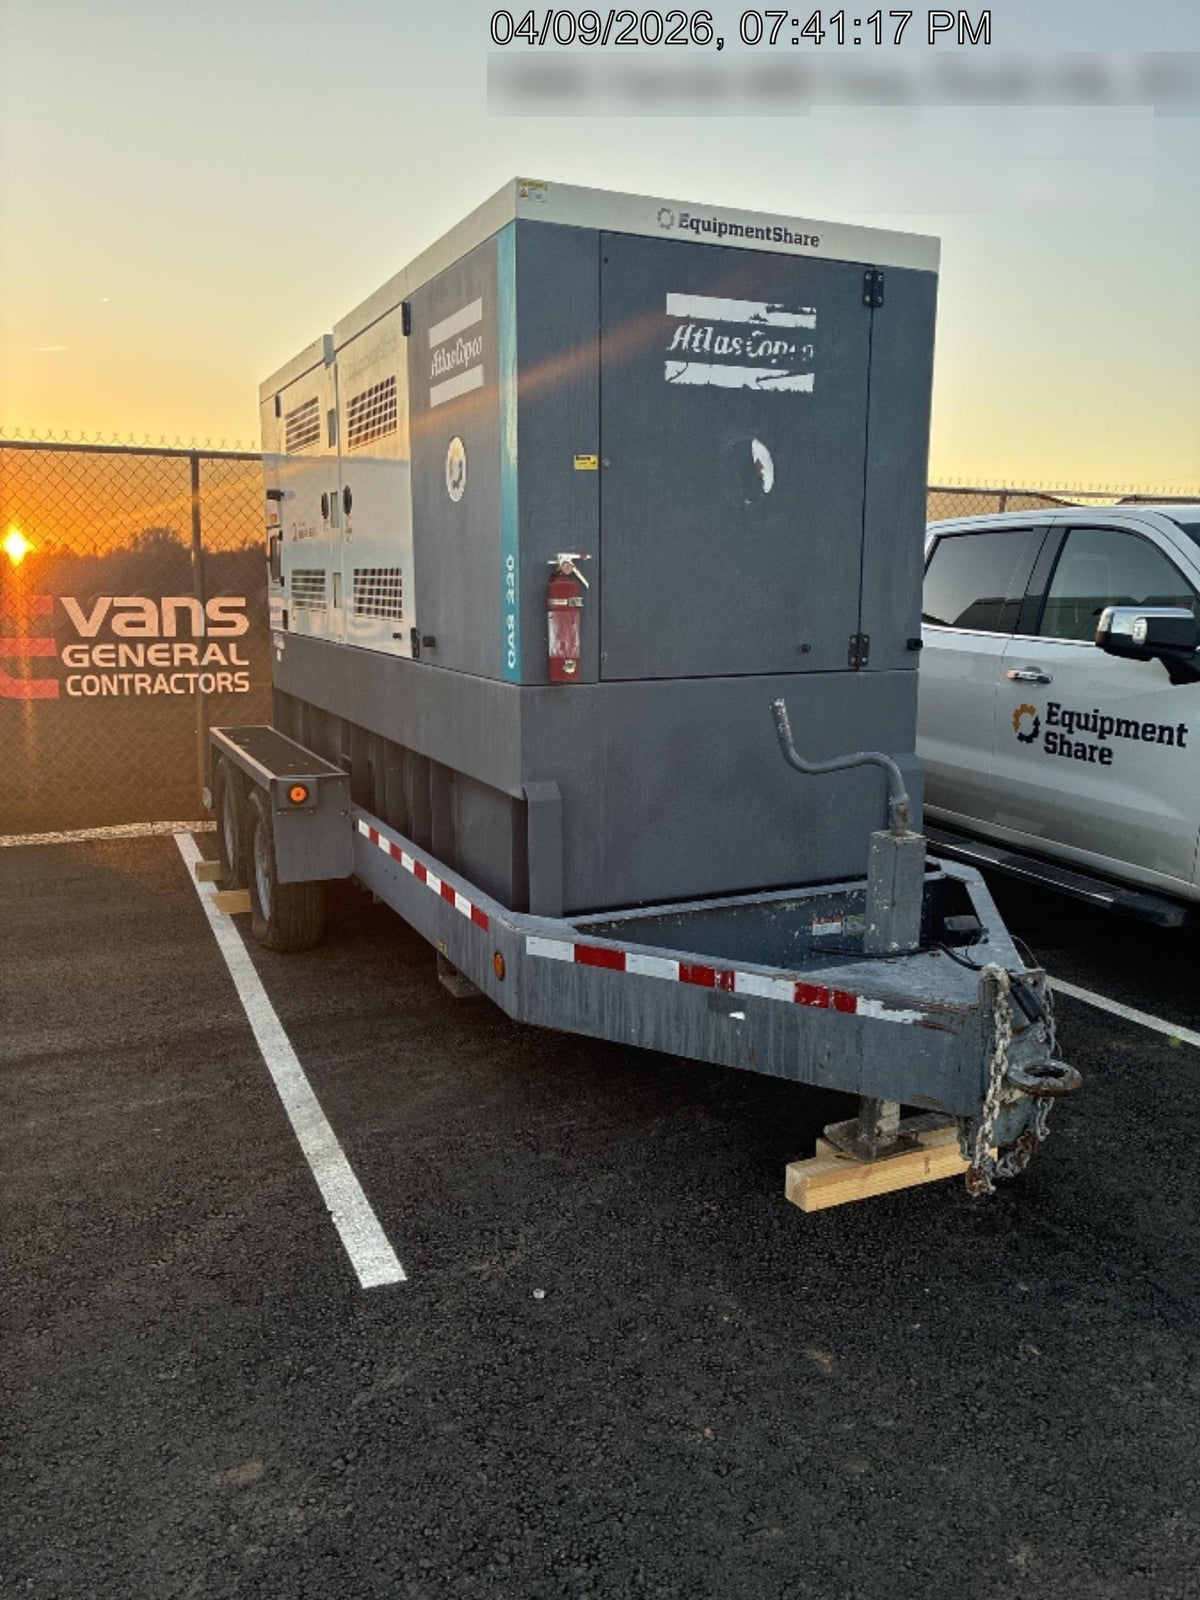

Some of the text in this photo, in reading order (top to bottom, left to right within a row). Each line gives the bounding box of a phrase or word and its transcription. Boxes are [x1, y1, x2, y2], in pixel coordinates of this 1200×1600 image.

[678, 211, 820, 248] EquipmentShare
[666, 323, 814, 364] Atlas Copo
[61, 642, 250, 668] GENERAL
[66, 671, 250, 697] CONTRACTORS
[1045, 702, 1188, 748] Equipment
[1043, 731, 1113, 766] Share
